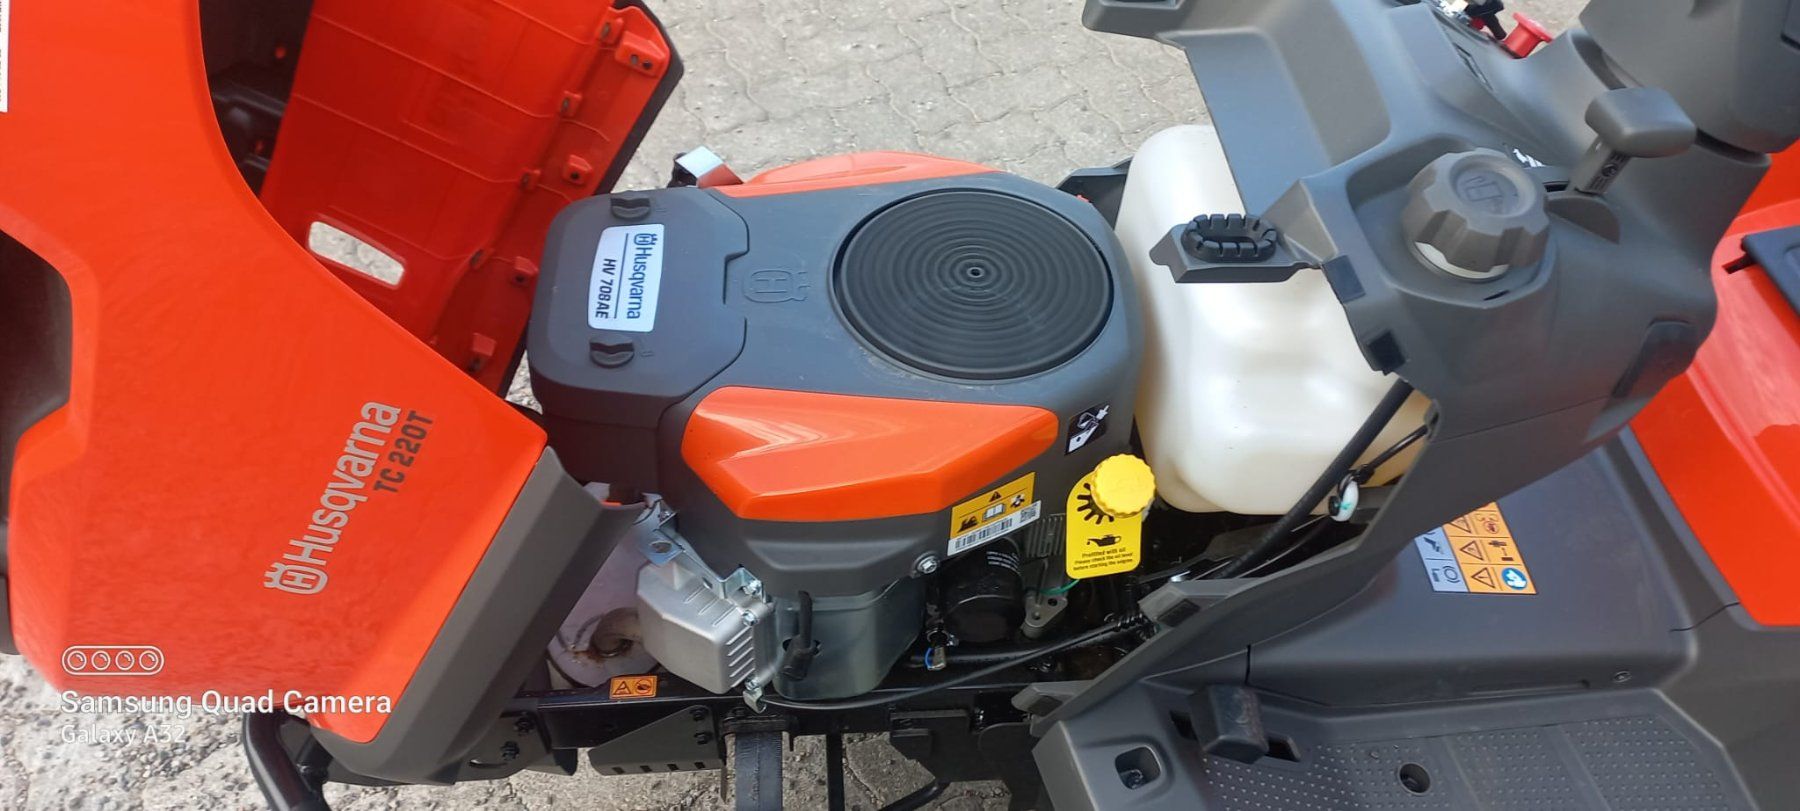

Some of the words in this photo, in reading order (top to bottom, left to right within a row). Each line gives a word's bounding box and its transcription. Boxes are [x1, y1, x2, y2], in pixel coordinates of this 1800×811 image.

[602, 258, 617, 276] HV
[626, 247, 654, 319] Husqvarna
[595, 279, 614, 319] 708AE
[388, 411, 433, 467] 220T
[283, 402, 401, 565] Husqvarna
[373, 468, 405, 493] TC
